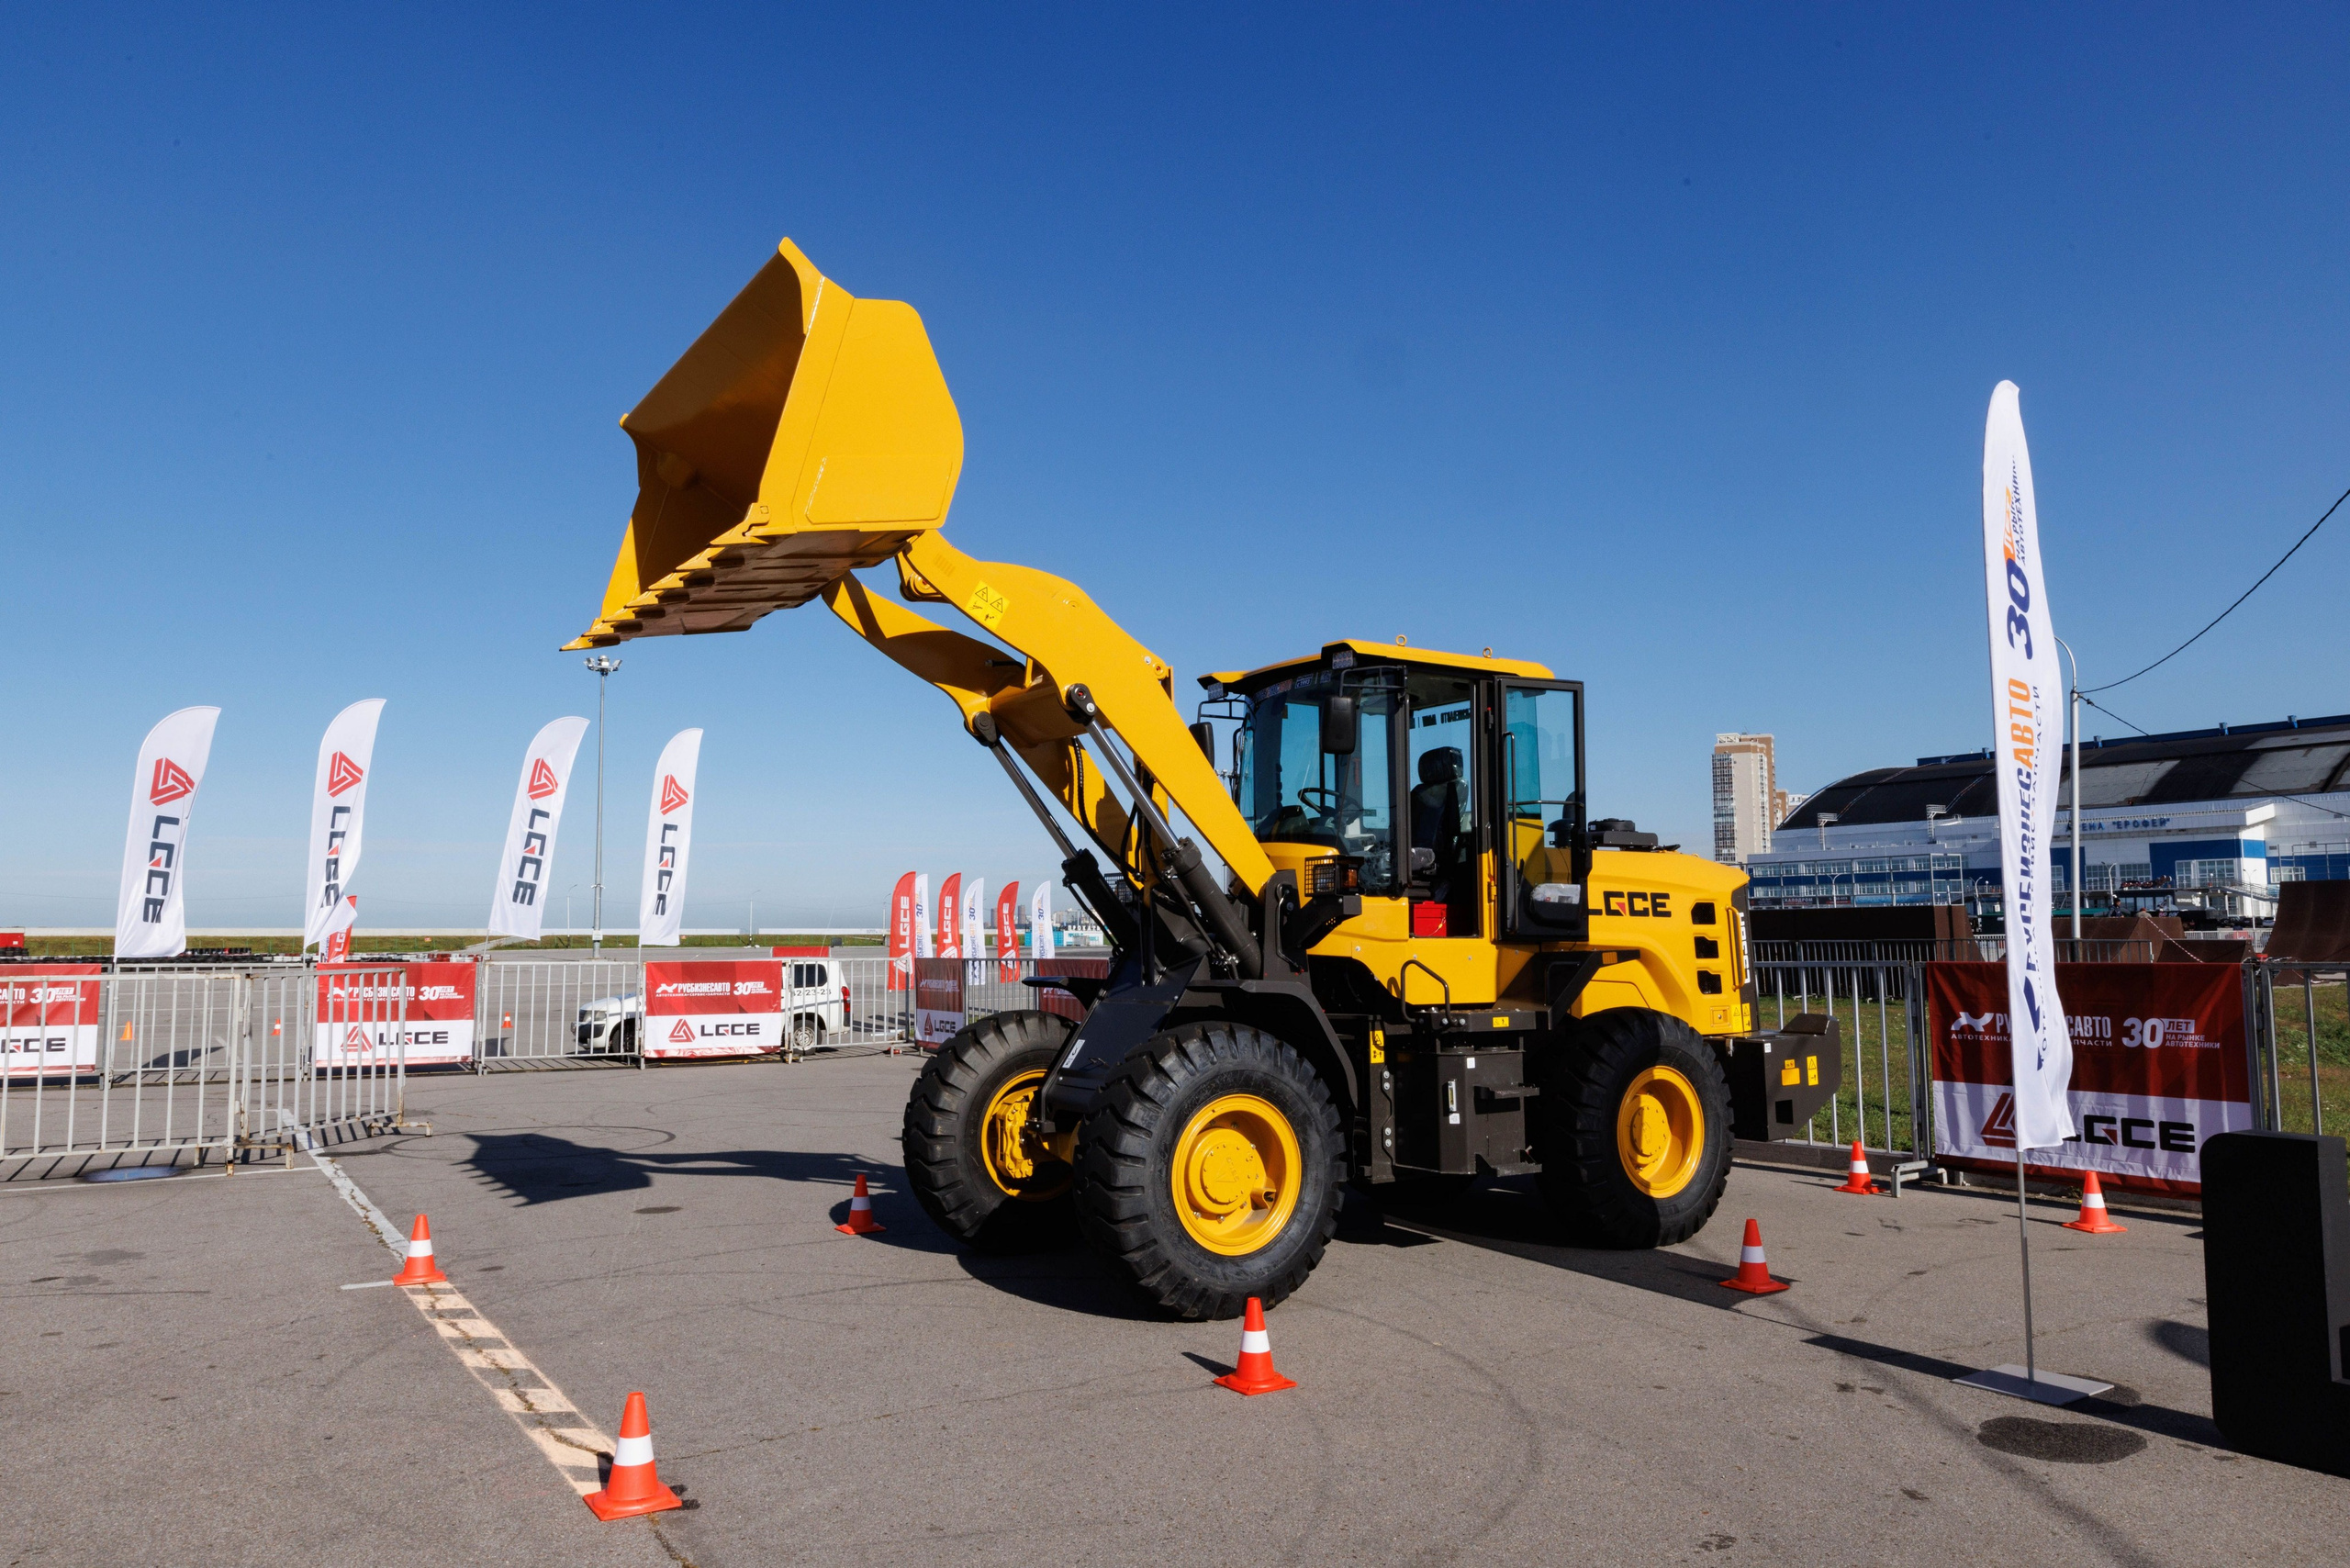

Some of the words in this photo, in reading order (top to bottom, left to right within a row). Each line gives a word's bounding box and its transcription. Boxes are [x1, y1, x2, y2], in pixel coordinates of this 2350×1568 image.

[2007, 558, 2032, 660] 30
[2065, 822, 2105, 832] АЕНА
[512, 808, 550, 906] LGCE
[142, 814, 180, 924] LGCE
[653, 823, 678, 916] LGCE
[916, 904, 923, 918] 30
[969, 907, 976, 920] 30
[1038, 909, 1045, 920] 30
[899, 896, 910, 948] LGCE
[943, 896, 953, 944] LGCE
[1003, 902, 1013, 947] LGCE
[29, 987, 55, 1004] 30
[419, 986, 440, 1001] 30
[677, 981, 731, 993] РУСБИЗНЕСАВТО
[733, 981, 750, 995] 30
[700, 1023, 760, 1036] LGCE
[934, 1019, 957, 1034] LGCE
[2121, 1017, 2165, 1048] 30
[2166, 1020, 2191, 1031] ЛЕТ
[378, 1031, 449, 1046] LGCE
[2165, 1041, 2221, 1049] АВТОТЕХНИКИ
[2177, 1034, 2205, 1042] РЫНКЕ
